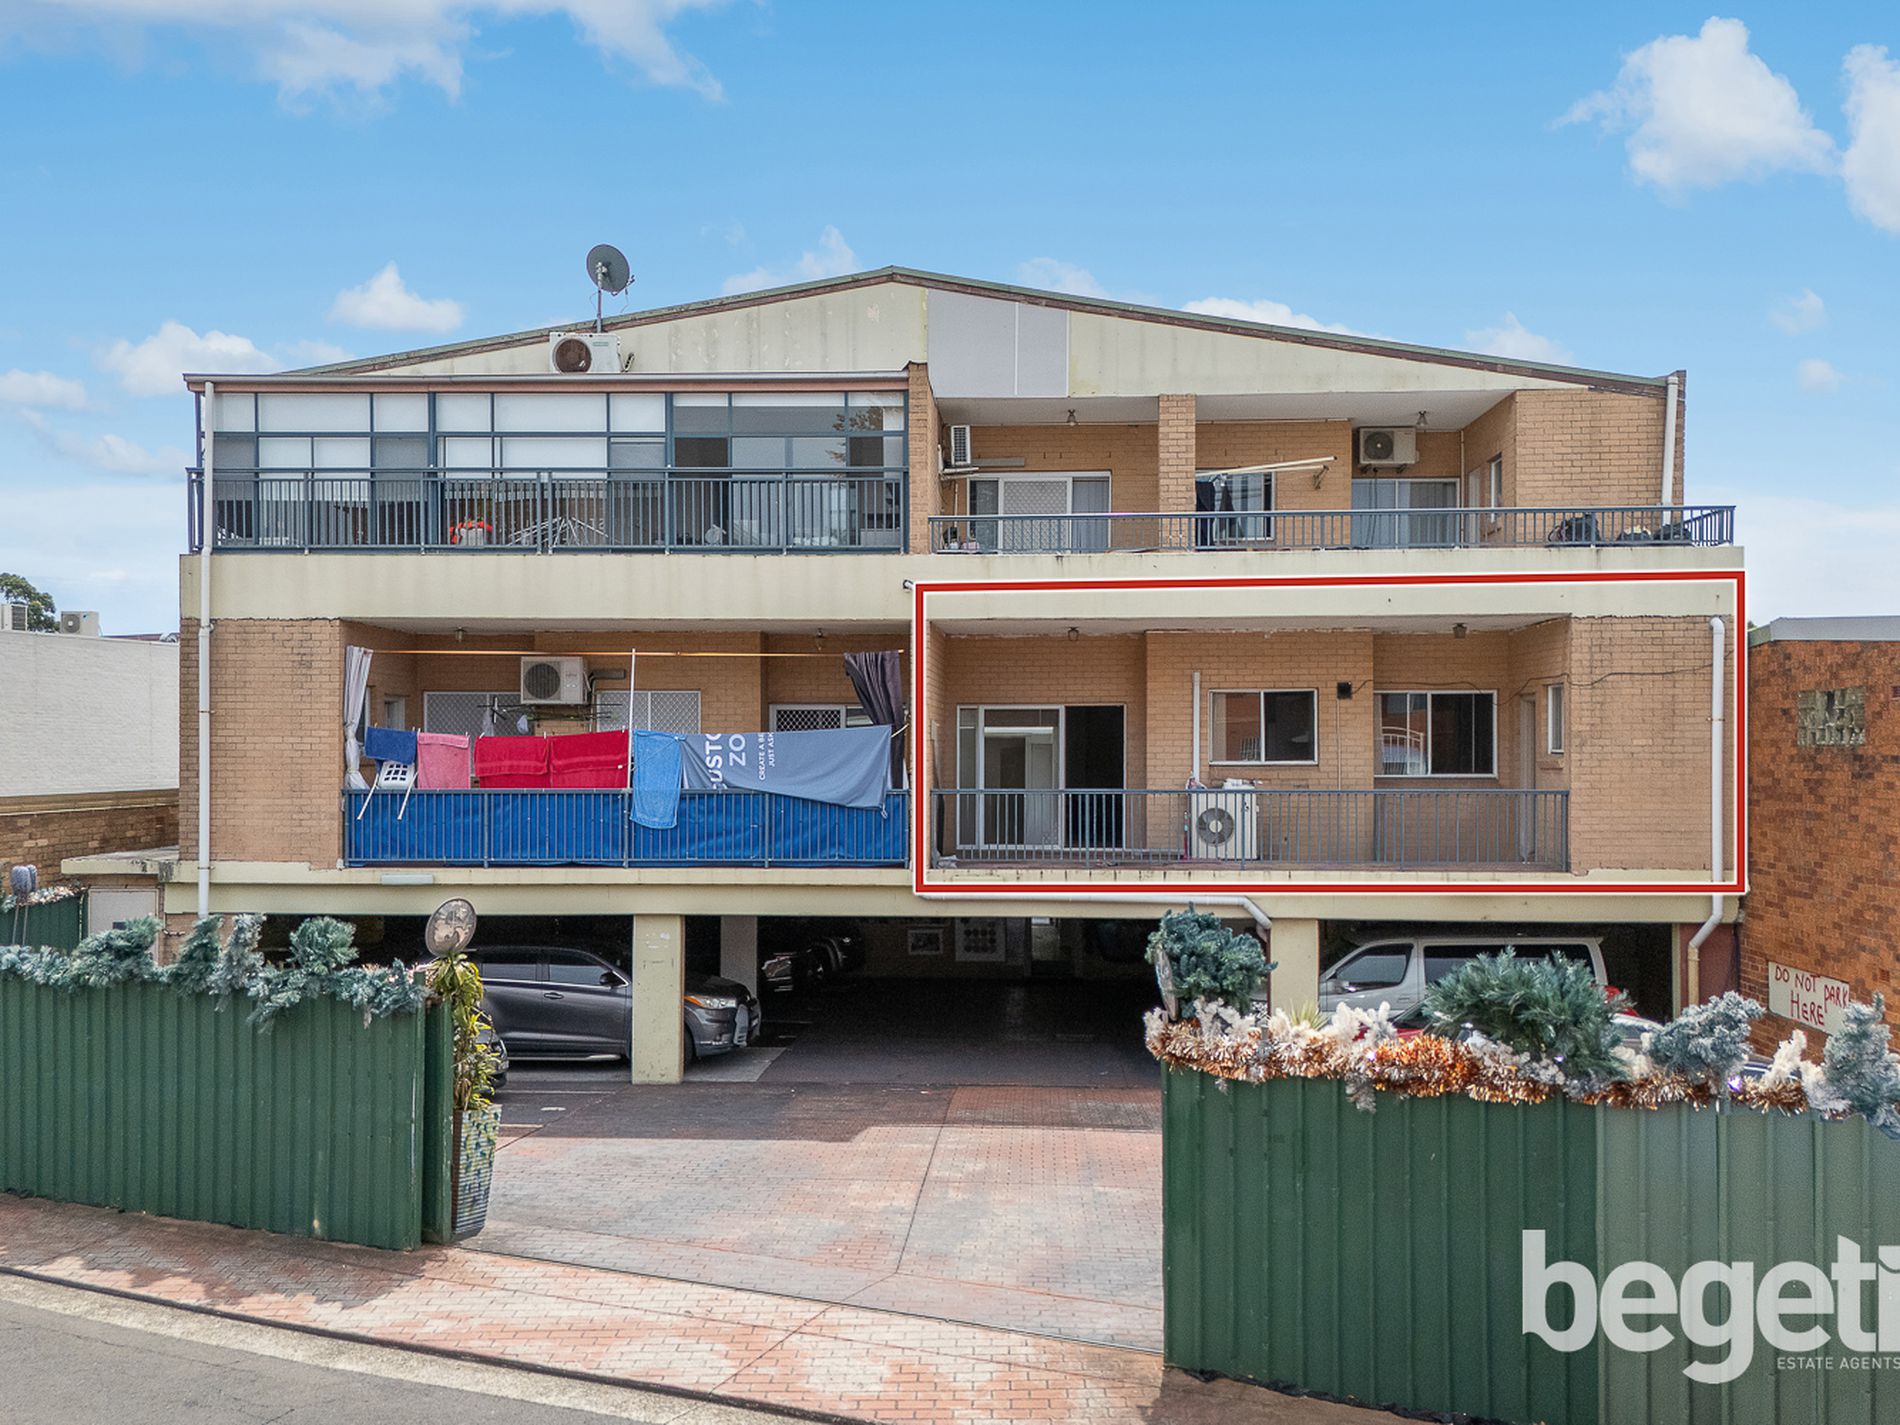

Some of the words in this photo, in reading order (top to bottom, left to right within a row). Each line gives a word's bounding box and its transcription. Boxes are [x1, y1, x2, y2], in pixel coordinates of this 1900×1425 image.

[758, 752, 766, 780] CREATE
[1775, 965, 1790, 983] DO
[1795, 973, 1820, 993] NOT
[1823, 984, 1848, 1014] PARK
[1790, 990, 1824, 1026] HERE
